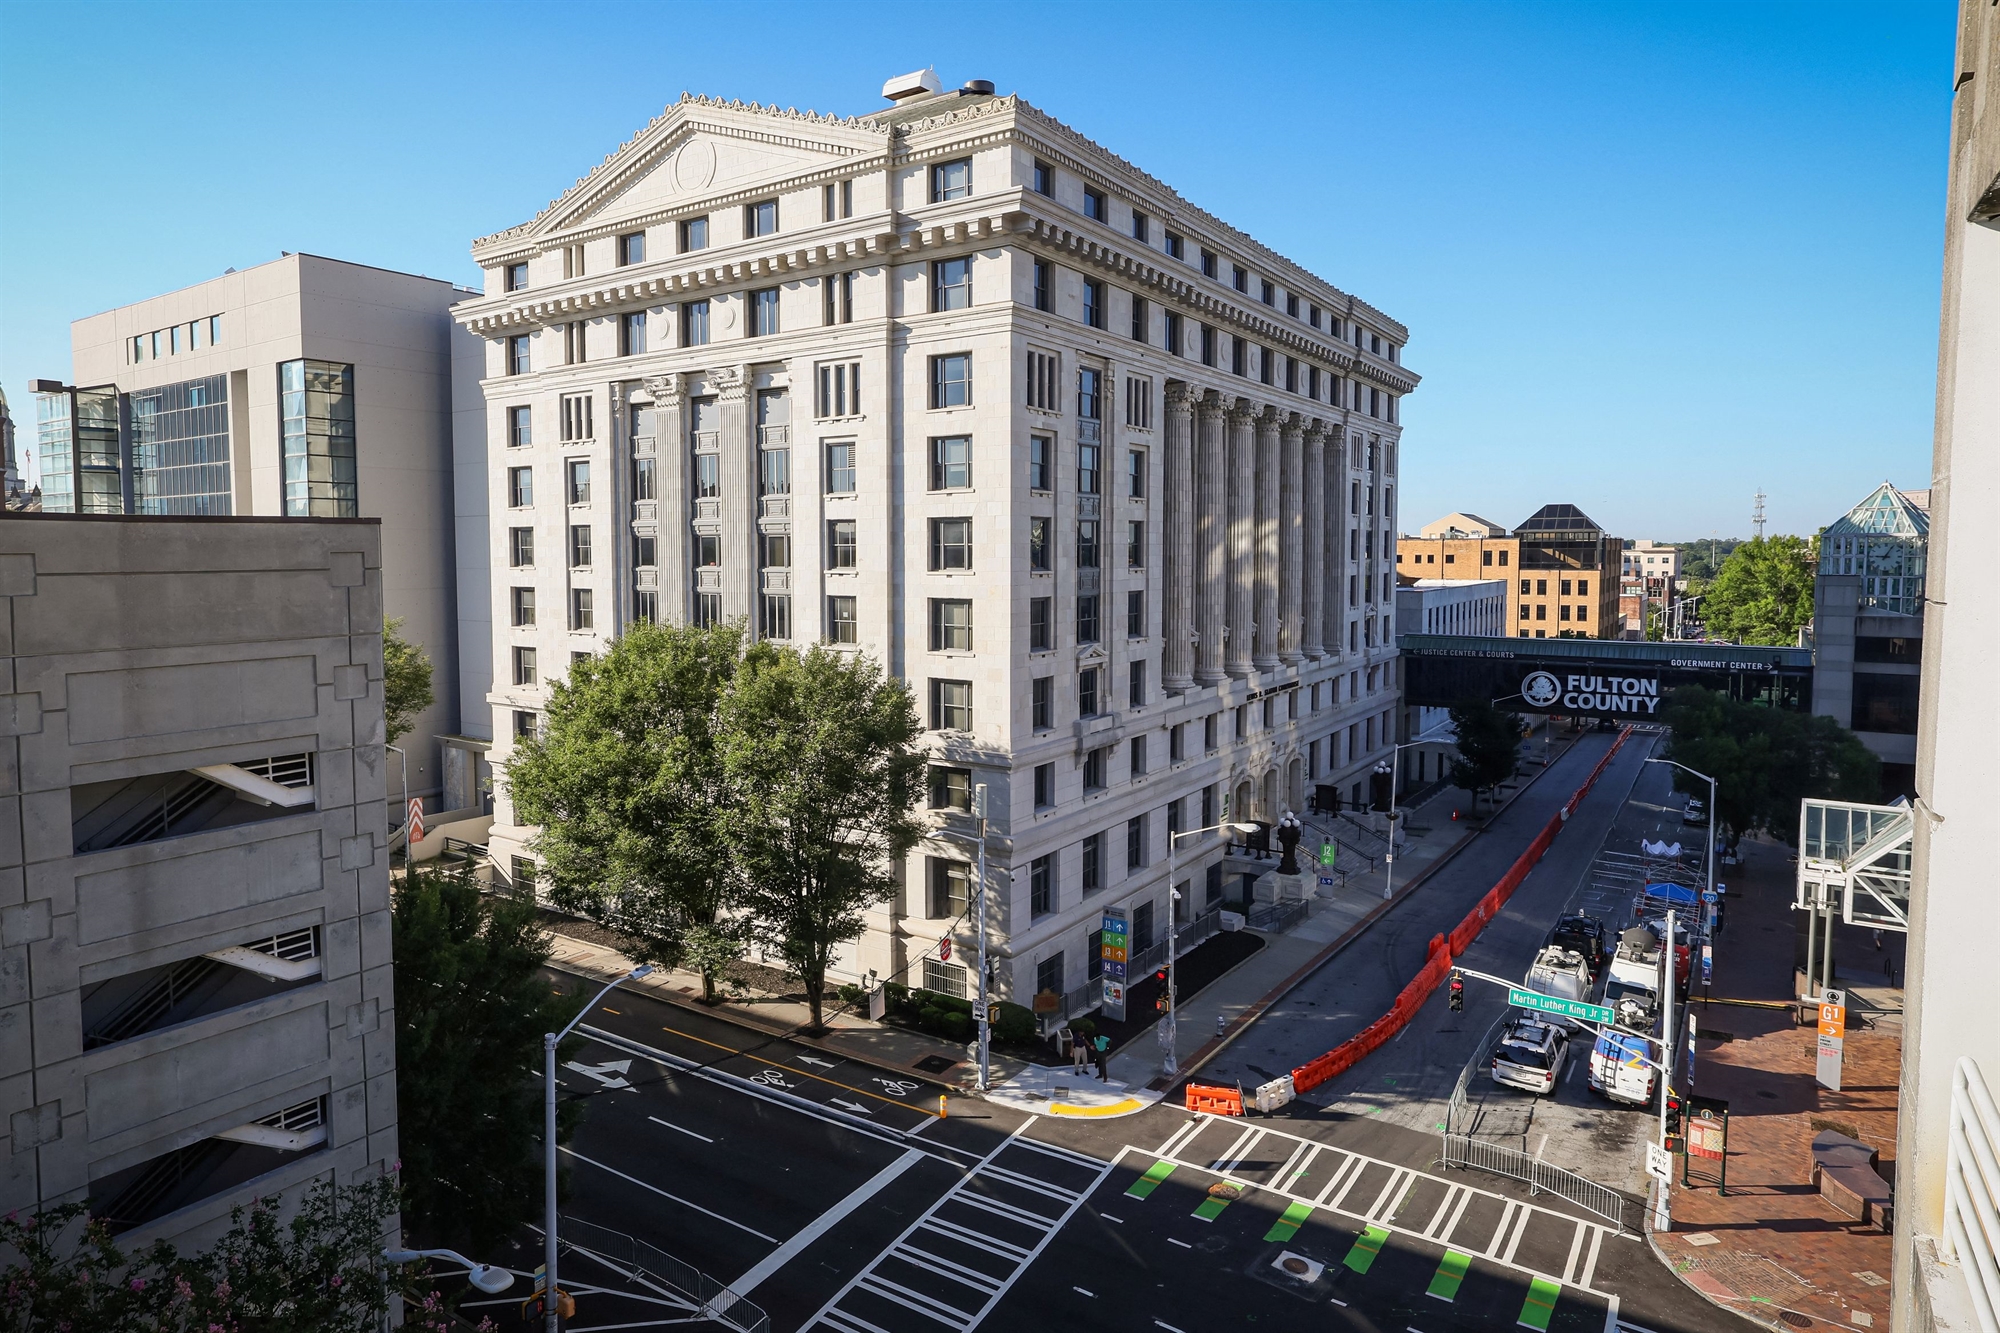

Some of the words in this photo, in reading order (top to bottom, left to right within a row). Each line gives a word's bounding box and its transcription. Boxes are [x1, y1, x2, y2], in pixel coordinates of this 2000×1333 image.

[1420, 648, 1448, 656] JUSTICE
[1449, 649, 1476, 657] CENTER
[1486, 651, 1515, 659] COURTS
[1671, 659, 1727, 668] GOVERNMENT
[1729, 661, 1763, 670] CENTER
[1567, 674, 1657, 696] FULTON
[1563, 692, 1660, 713] COUNTY
[1322, 845, 1332, 856] J2
[1705, 894, 1714, 902] 20
[1104, 920, 1111, 930] J1
[1104, 933, 1111, 943] J2
[1104, 947, 1111, 956] J3
[1104, 962, 1111, 971] J4
[1513, 992, 1537, 1006] Martin
[1540, 998, 1566, 1011] Luther
[1569, 1003, 1586, 1018] King
[1589, 1008, 1598, 1018] Jr
[1823, 1005, 1839, 1020] G1
[1651, 1146, 1667, 1160] ONE
[1651, 1154, 1667, 1168] WAY
